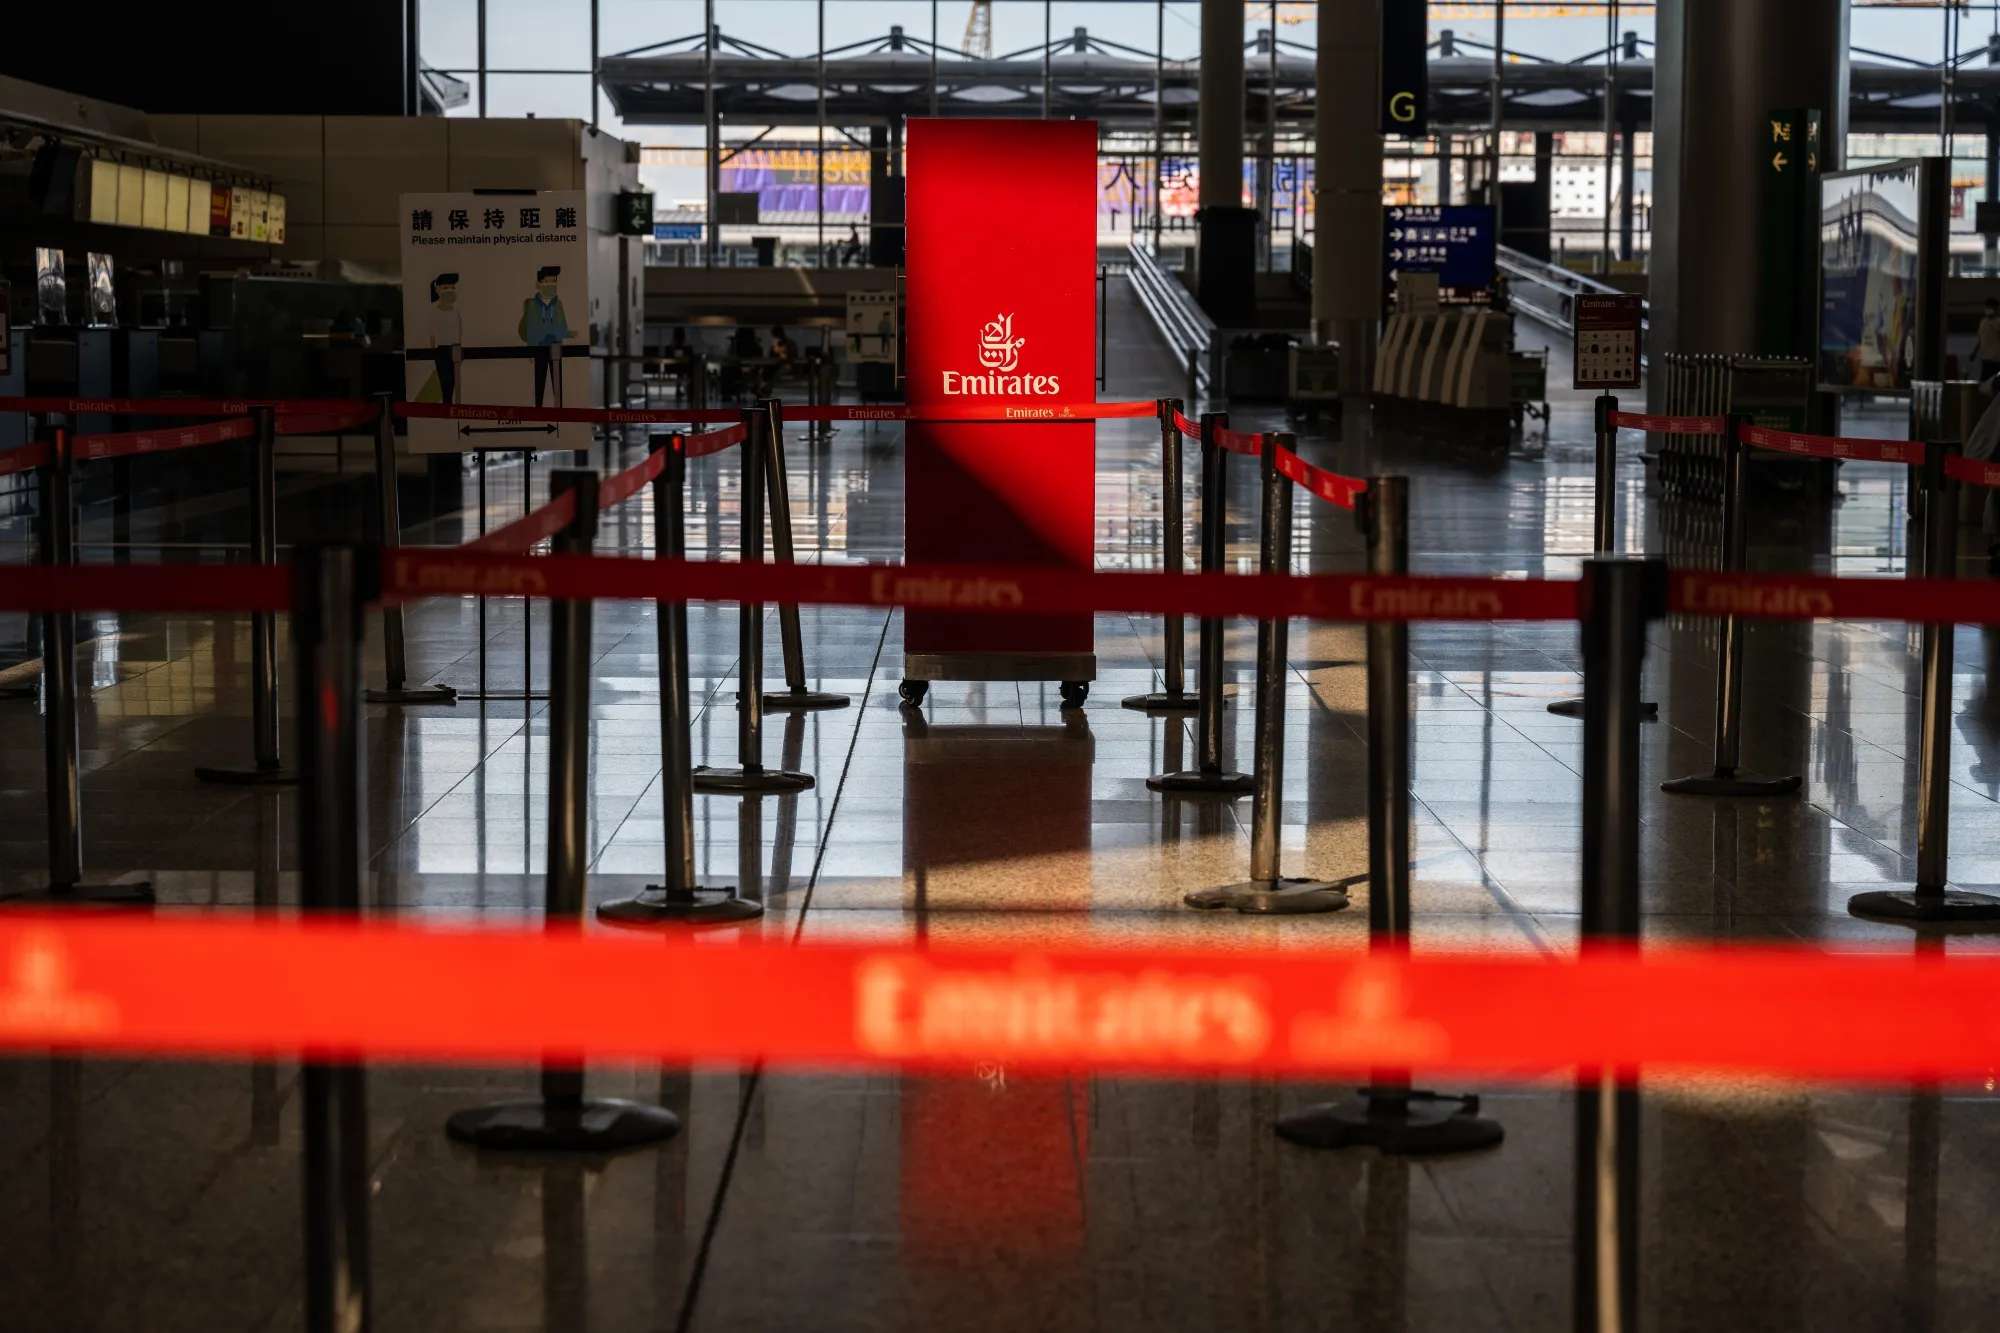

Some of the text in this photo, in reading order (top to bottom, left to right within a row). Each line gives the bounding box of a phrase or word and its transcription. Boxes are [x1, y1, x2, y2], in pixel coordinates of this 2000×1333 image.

[1389, 91, 1416, 122] G
[411, 207, 577, 231] 請保持距離
[412, 233, 577, 246] Please maintain physical distance
[1582, 298, 1617, 309] Emirates
[941, 369, 1060, 396] Emirates
[68, 399, 117, 412] Emirates
[1005, 406, 1054, 418] Emirates
[449, 407, 498, 419] Emirates
[608, 410, 657, 423] Emirates
[847, 407, 896, 419] Emirates
